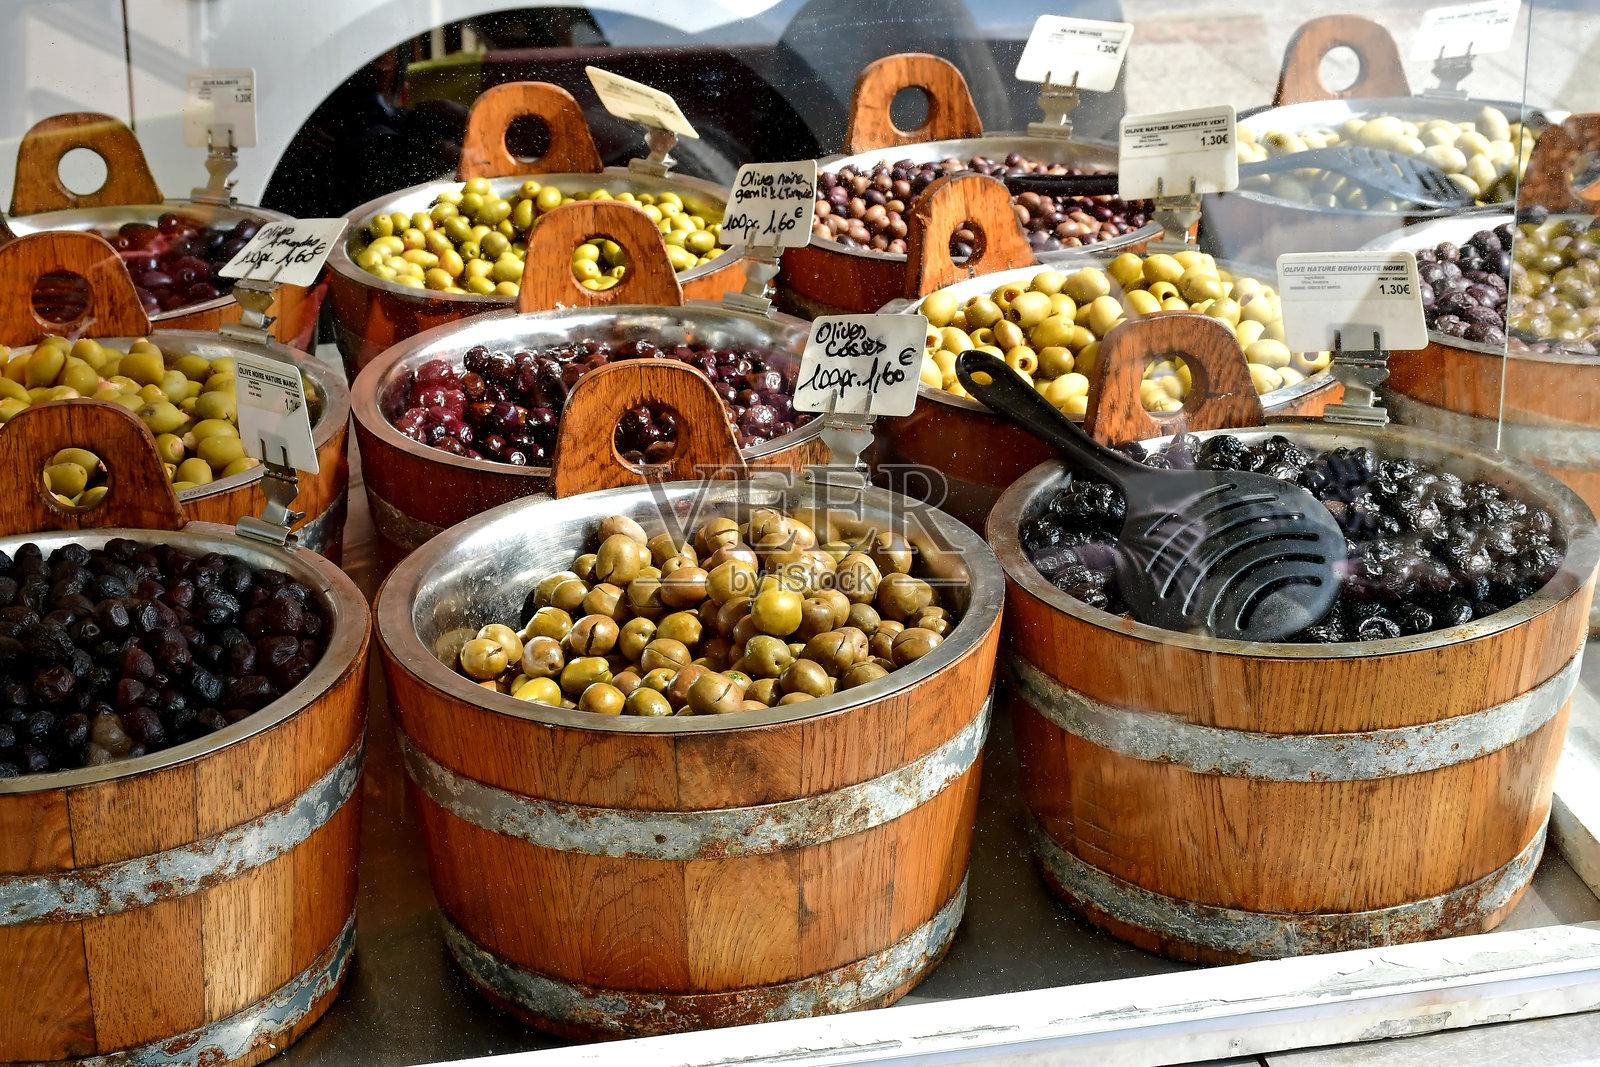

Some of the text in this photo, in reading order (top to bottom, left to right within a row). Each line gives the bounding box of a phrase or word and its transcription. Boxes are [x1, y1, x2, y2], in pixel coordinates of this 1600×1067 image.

[1200, 134, 1229, 146] 1.30€
[1284, 265, 1305, 273] OLIVE
[1307, 265, 1336, 273] NATURE
[1382, 264, 1405, 272] NOIRE
[1379, 283, 1411, 295] 1.30€
[816, 322, 867, 344] Olives
[239, 367, 252, 377] OLIVE
[252, 369, 265, 380] NOIRE
[265, 374, 283, 386] NATURE
[282, 378, 298, 389] MAROC
